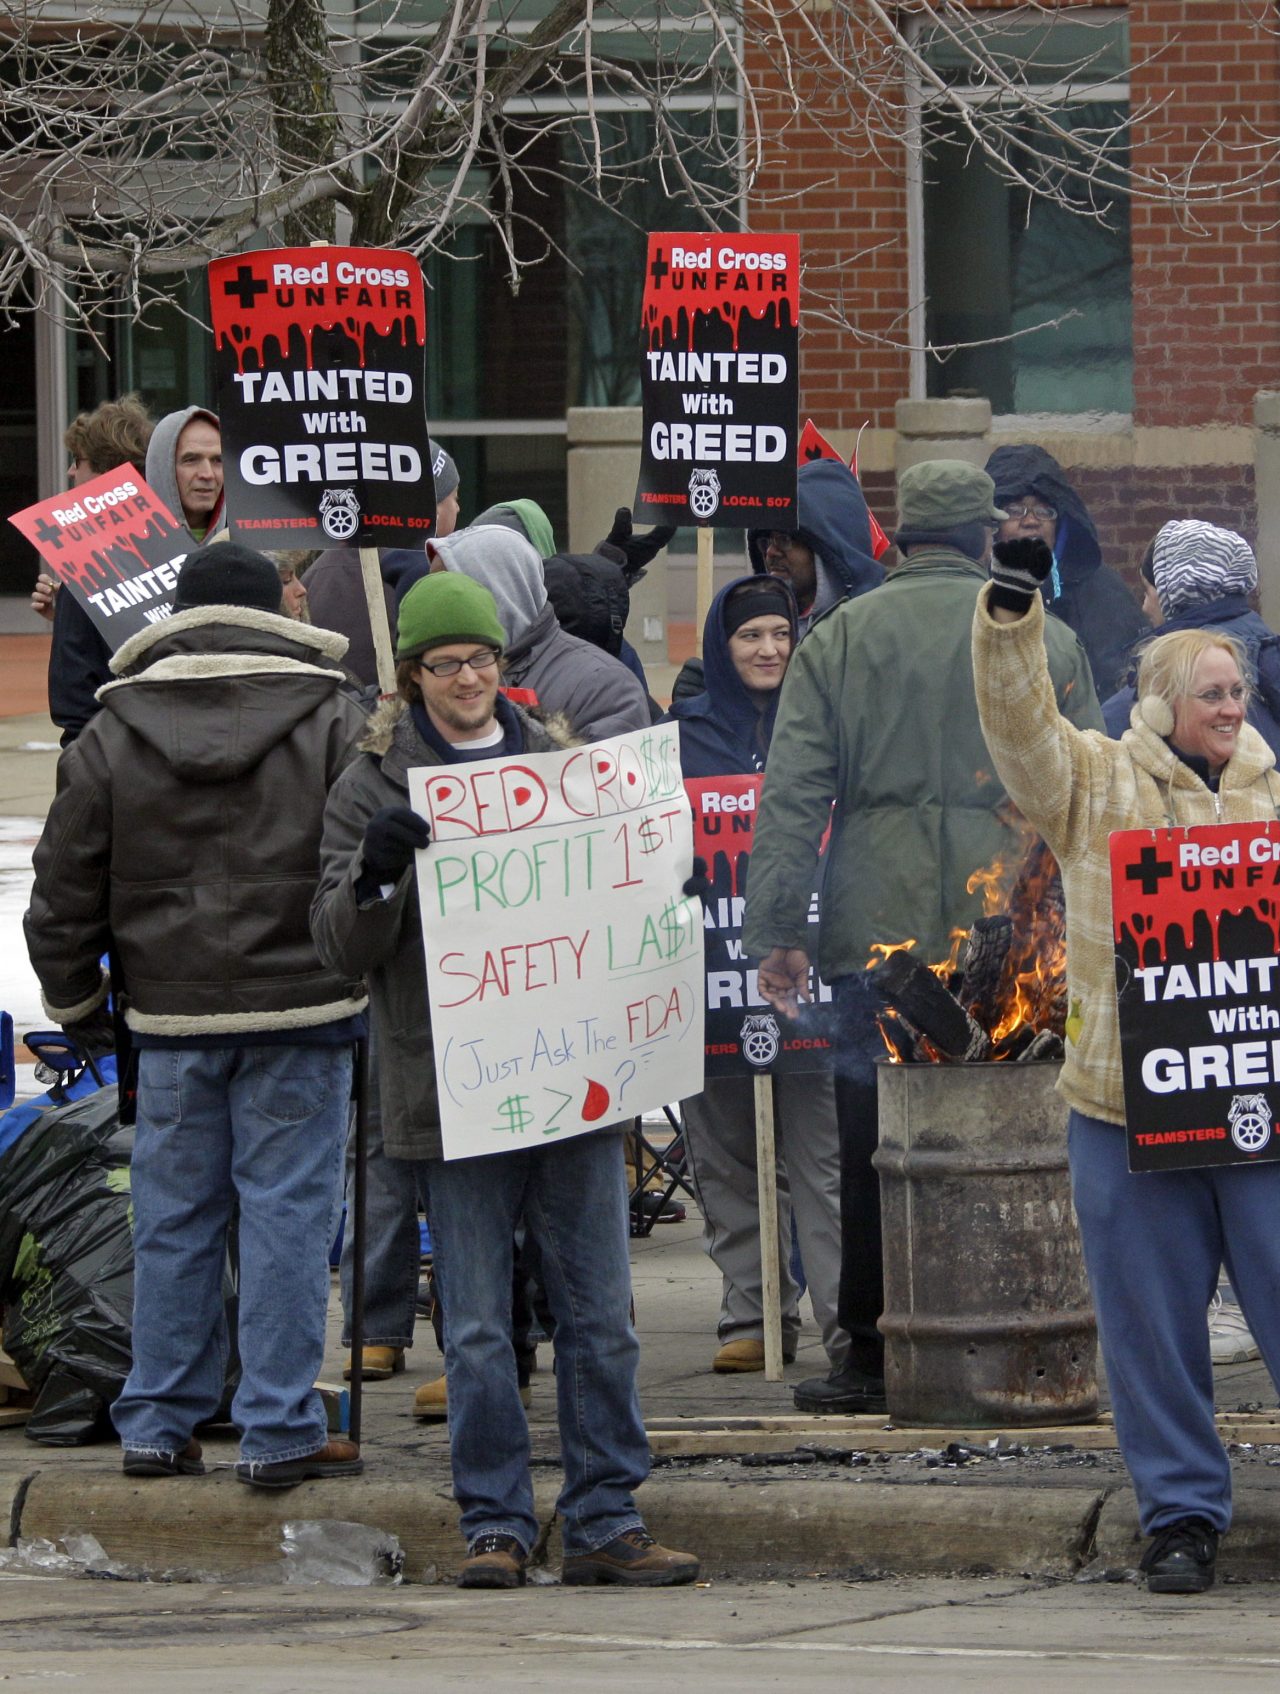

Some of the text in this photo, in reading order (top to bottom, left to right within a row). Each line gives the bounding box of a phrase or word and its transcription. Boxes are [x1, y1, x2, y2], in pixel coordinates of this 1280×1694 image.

[672, 248, 786, 270] Red Cross
[273, 262, 409, 287] Red Cross
[672, 272, 787, 291] UNFAIR
[275, 287, 411, 309] UNFAIR
[647, 352, 787, 383] TAINTED
[234, 369, 413, 404] TAINTED
[682, 393, 733, 415] With
[302, 410, 367, 434] With
[651, 422, 787, 462] GREED
[239, 442, 422, 485] GREED
[52, 481, 138, 527] Red Cross
[641, 493, 791, 507] TEAMSTERS LOCAL 507
[66, 495, 152, 542] UNFAIR
[235, 515, 430, 529] TEAMSTERS LOCAL 507
[426, 765, 548, 841] RED
[702, 789, 755, 813] Red
[1179, 840, 1239, 867] Red
[435, 830, 605, 916] PROFIT
[439, 929, 589, 1008] SAFETY
[1208, 1004, 1280, 1034] With
[577, 1017, 616, 1055] The
[783, 1038, 830, 1050] LOCAL
[1135, 1128, 1226, 1146] TEAMSTERS
